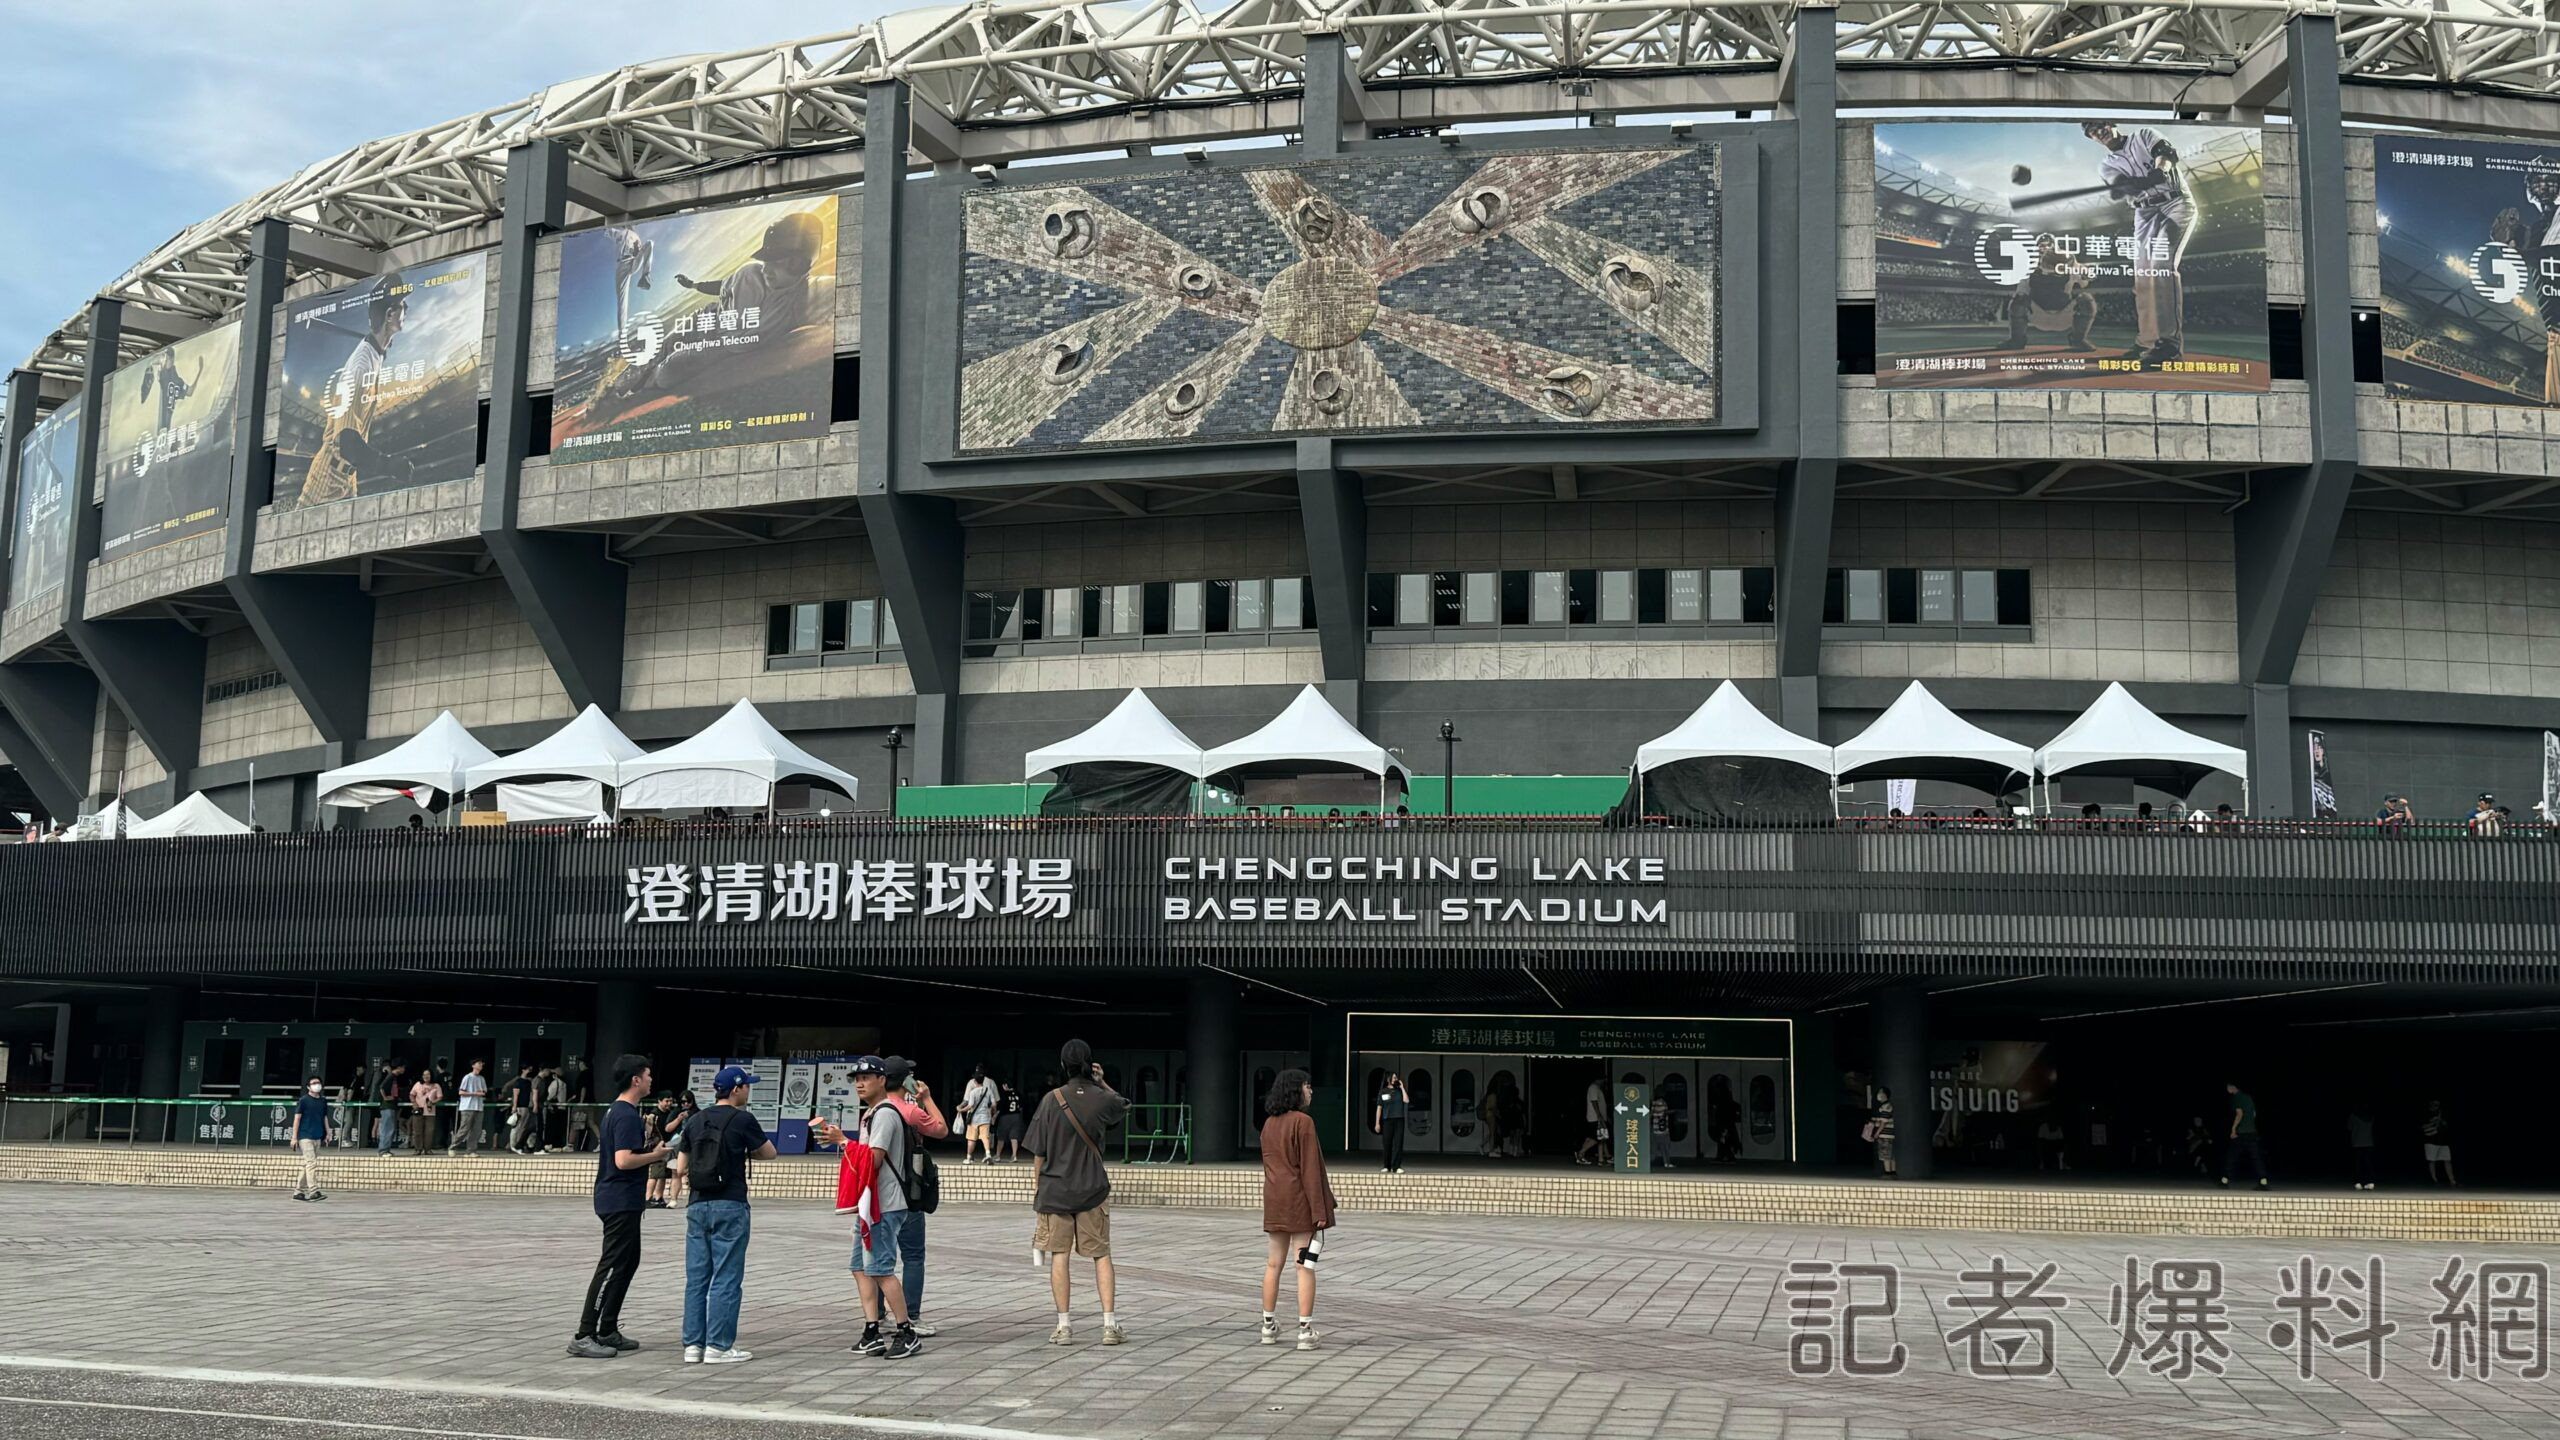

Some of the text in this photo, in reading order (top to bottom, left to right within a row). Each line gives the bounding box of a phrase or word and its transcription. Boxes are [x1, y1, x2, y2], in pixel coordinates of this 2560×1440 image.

[2392, 151, 2474, 168] 澄清湖棒球場
[2054, 234, 2170, 260] 中華電信
[2054, 263, 2170, 279] Chunghwa Telecom
[673, 306, 761, 336] 中華電信
[673, 334, 759, 352] Chunghwa Telecom
[1895, 358, 1986, 371] 澄清湖棒球場
[2098, 359, 2141, 372] 精彩5G
[362, 359, 426, 390] 中華電信
[1165, 857, 1665, 882] CHENGCHING LAKE
[624, 857, 1074, 924] 澄清湖棒球場
[1165, 897, 1667, 923] BASEBALL STADIUM
[221, 1025, 229, 1036] 1
[281, 1025, 289, 1036] 2
[344, 1025, 352, 1036] 3
[407, 1025, 415, 1036] 4
[472, 1025, 480, 1036] 5
[537, 1025, 545, 1036] 6
[1431, 1028, 1556, 1047] 澄清湖棒球場
[1580, 1029, 1706, 1040] CHENGCHING LAKE
[1580, 1040, 1706, 1050] BASEBALL STADIUM
[199, 1124, 234, 1139] 售票處
[1626, 1119, 1639, 1169] 球迷入口
